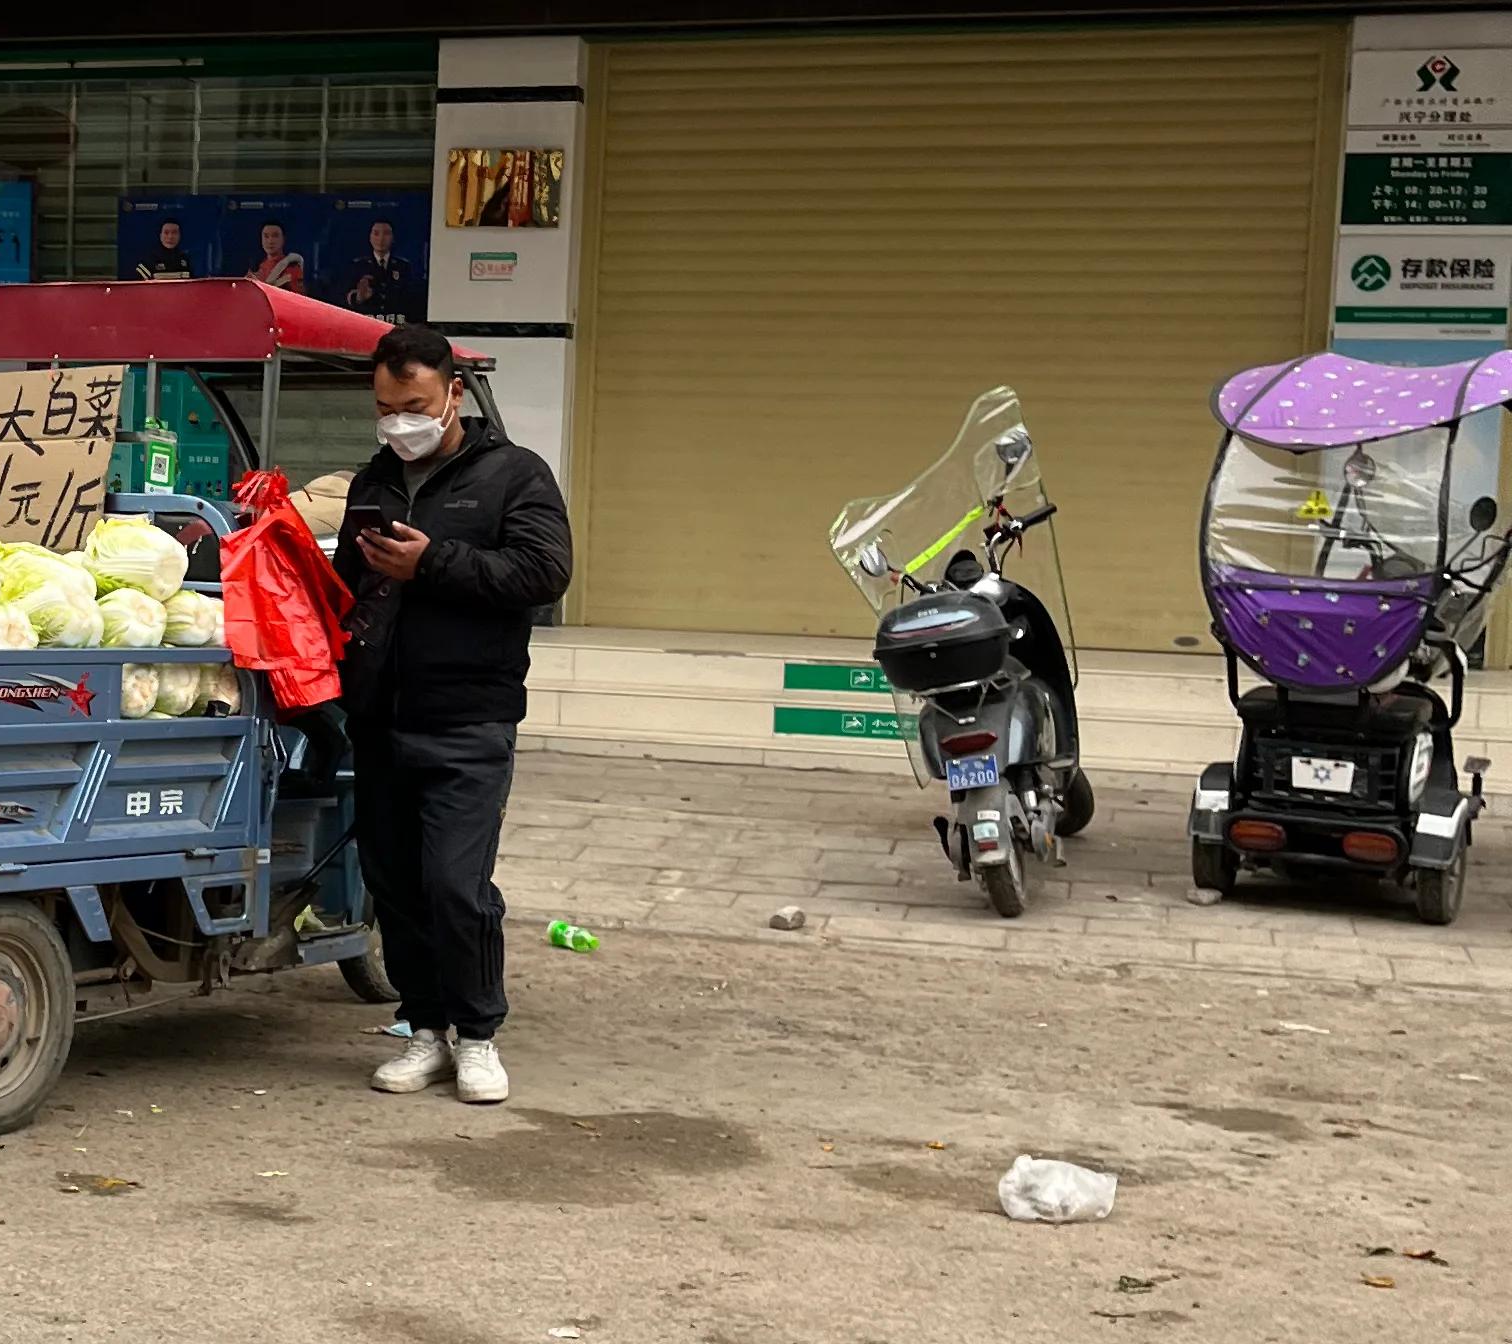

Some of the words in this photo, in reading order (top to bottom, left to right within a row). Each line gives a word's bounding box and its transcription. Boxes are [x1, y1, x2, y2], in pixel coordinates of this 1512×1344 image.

[1400, 258, 1495, 278] 存款保险
[952, 769, 995, 787] 06200
[126, 789, 184, 816] 申宗
